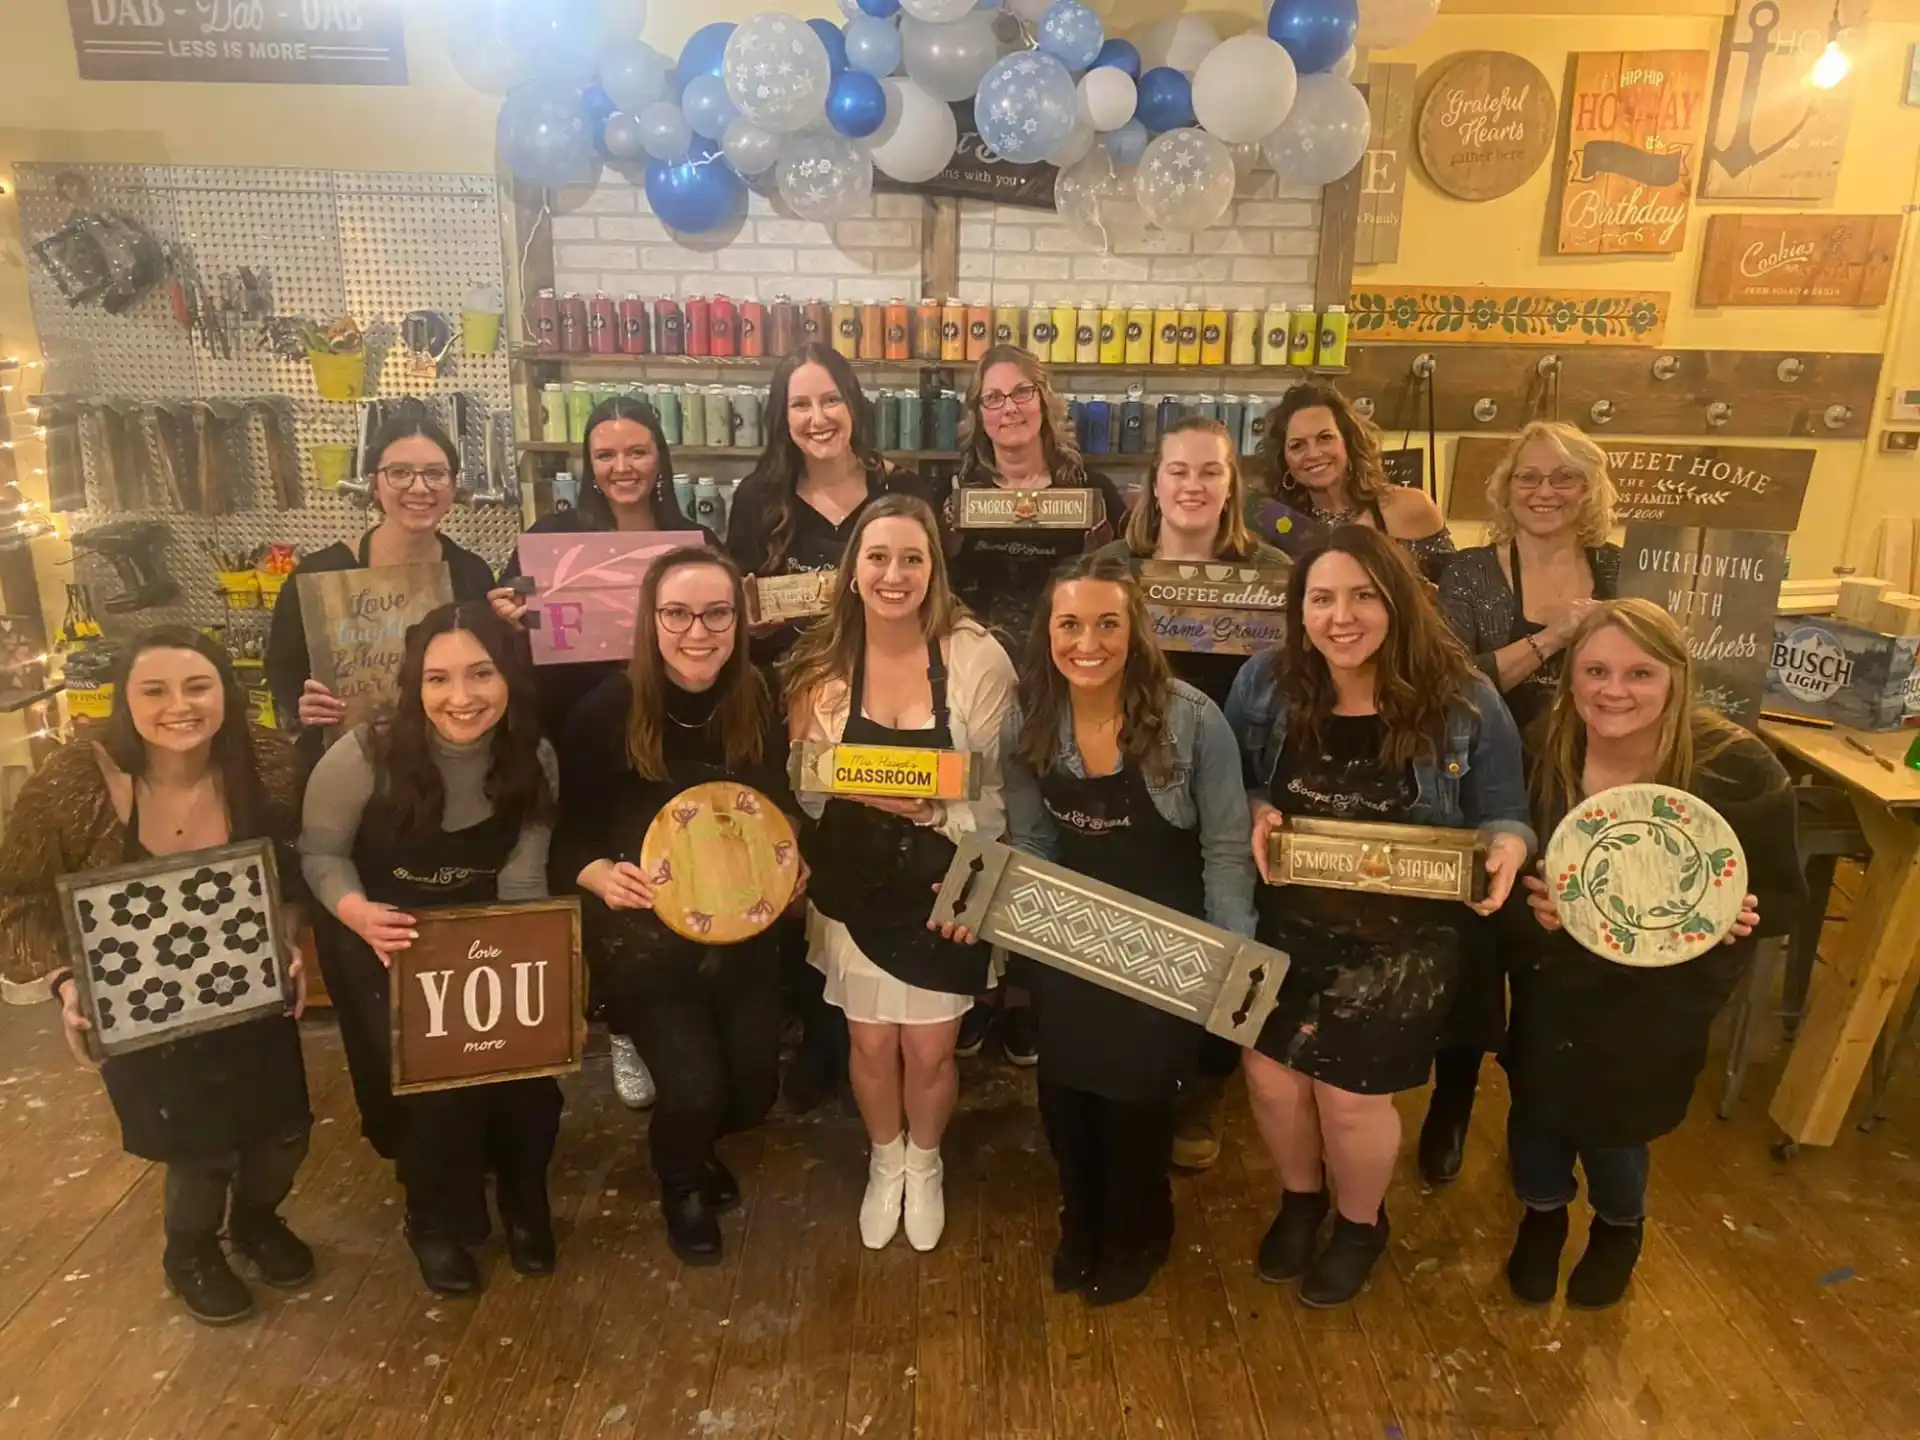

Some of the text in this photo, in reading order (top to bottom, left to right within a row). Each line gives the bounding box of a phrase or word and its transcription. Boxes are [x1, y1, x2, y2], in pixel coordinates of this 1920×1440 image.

[168, 40, 307, 61] LESS IS MORE
[1620, 69, 1665, 88] HIP HIP
[1441, 84, 1530, 128] Grateful
[1459, 115, 1524, 147] Hearts
[963, 168, 993, 184] with
[994, 174, 1018, 188] you
[1361, 149, 1397, 194] E
[1566, 184, 1686, 246] Birthday
[1607, 451, 1772, 494] WEET HOME
[1618, 478, 1645, 488] THE
[969, 499, 1083, 515] S'MORES STATION
[1633, 493, 1684, 505] FAMILY
[1632, 508, 1665, 520] 2008
[1638, 548, 1765, 582] OVERFLOWING
[349, 586, 407, 622] Love
[1149, 584, 1287, 606] COFFEE addict
[1668, 589, 1723, 617] WITH
[544, 602, 584, 651] F
[1152, 615, 1283, 643] Home Grown
[1772, 643, 1852, 685] BUSCH
[1785, 671, 1831, 693] LIGHT
[835, 767, 932, 786] CLASSROOM
[1294, 850, 1458, 881] S'MORES STATION
[467, 939, 502, 960] love
[415, 960, 548, 1037] YOU
[463, 1039, 507, 1053] more
